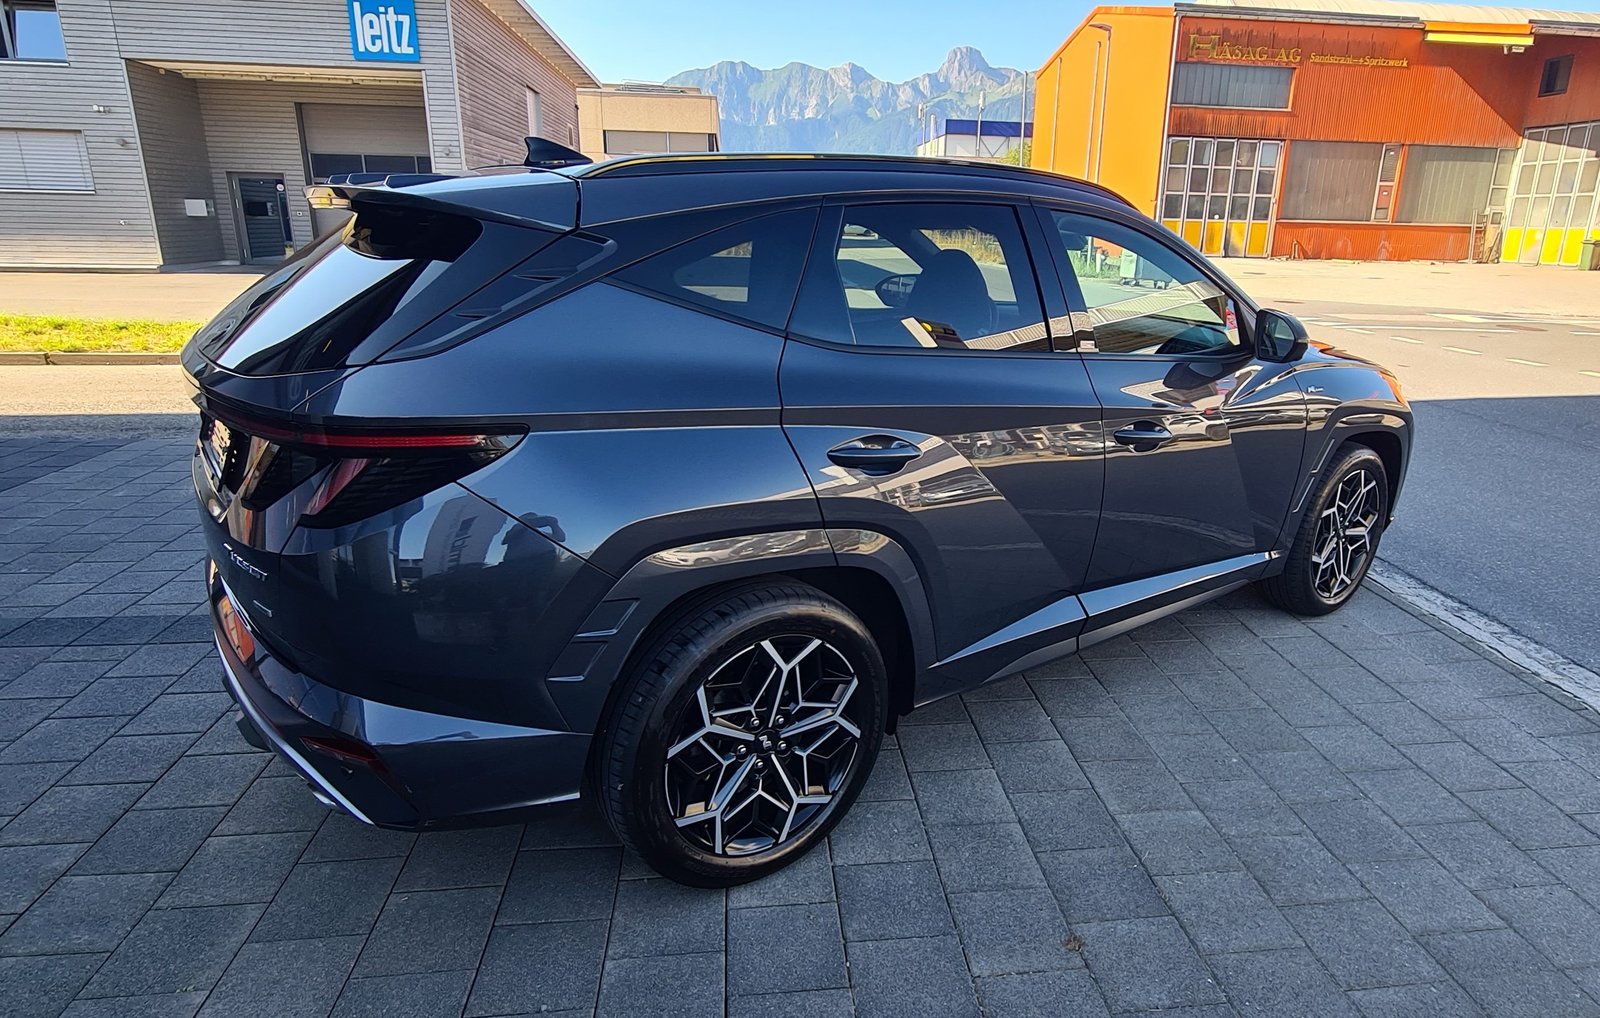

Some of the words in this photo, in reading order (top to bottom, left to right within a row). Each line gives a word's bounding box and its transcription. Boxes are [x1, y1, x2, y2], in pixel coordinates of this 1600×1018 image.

[353, 1, 414, 54] leitz
[1189, 34, 1268, 60] HÄSAG
[1275, 47, 1301, 62] AG
